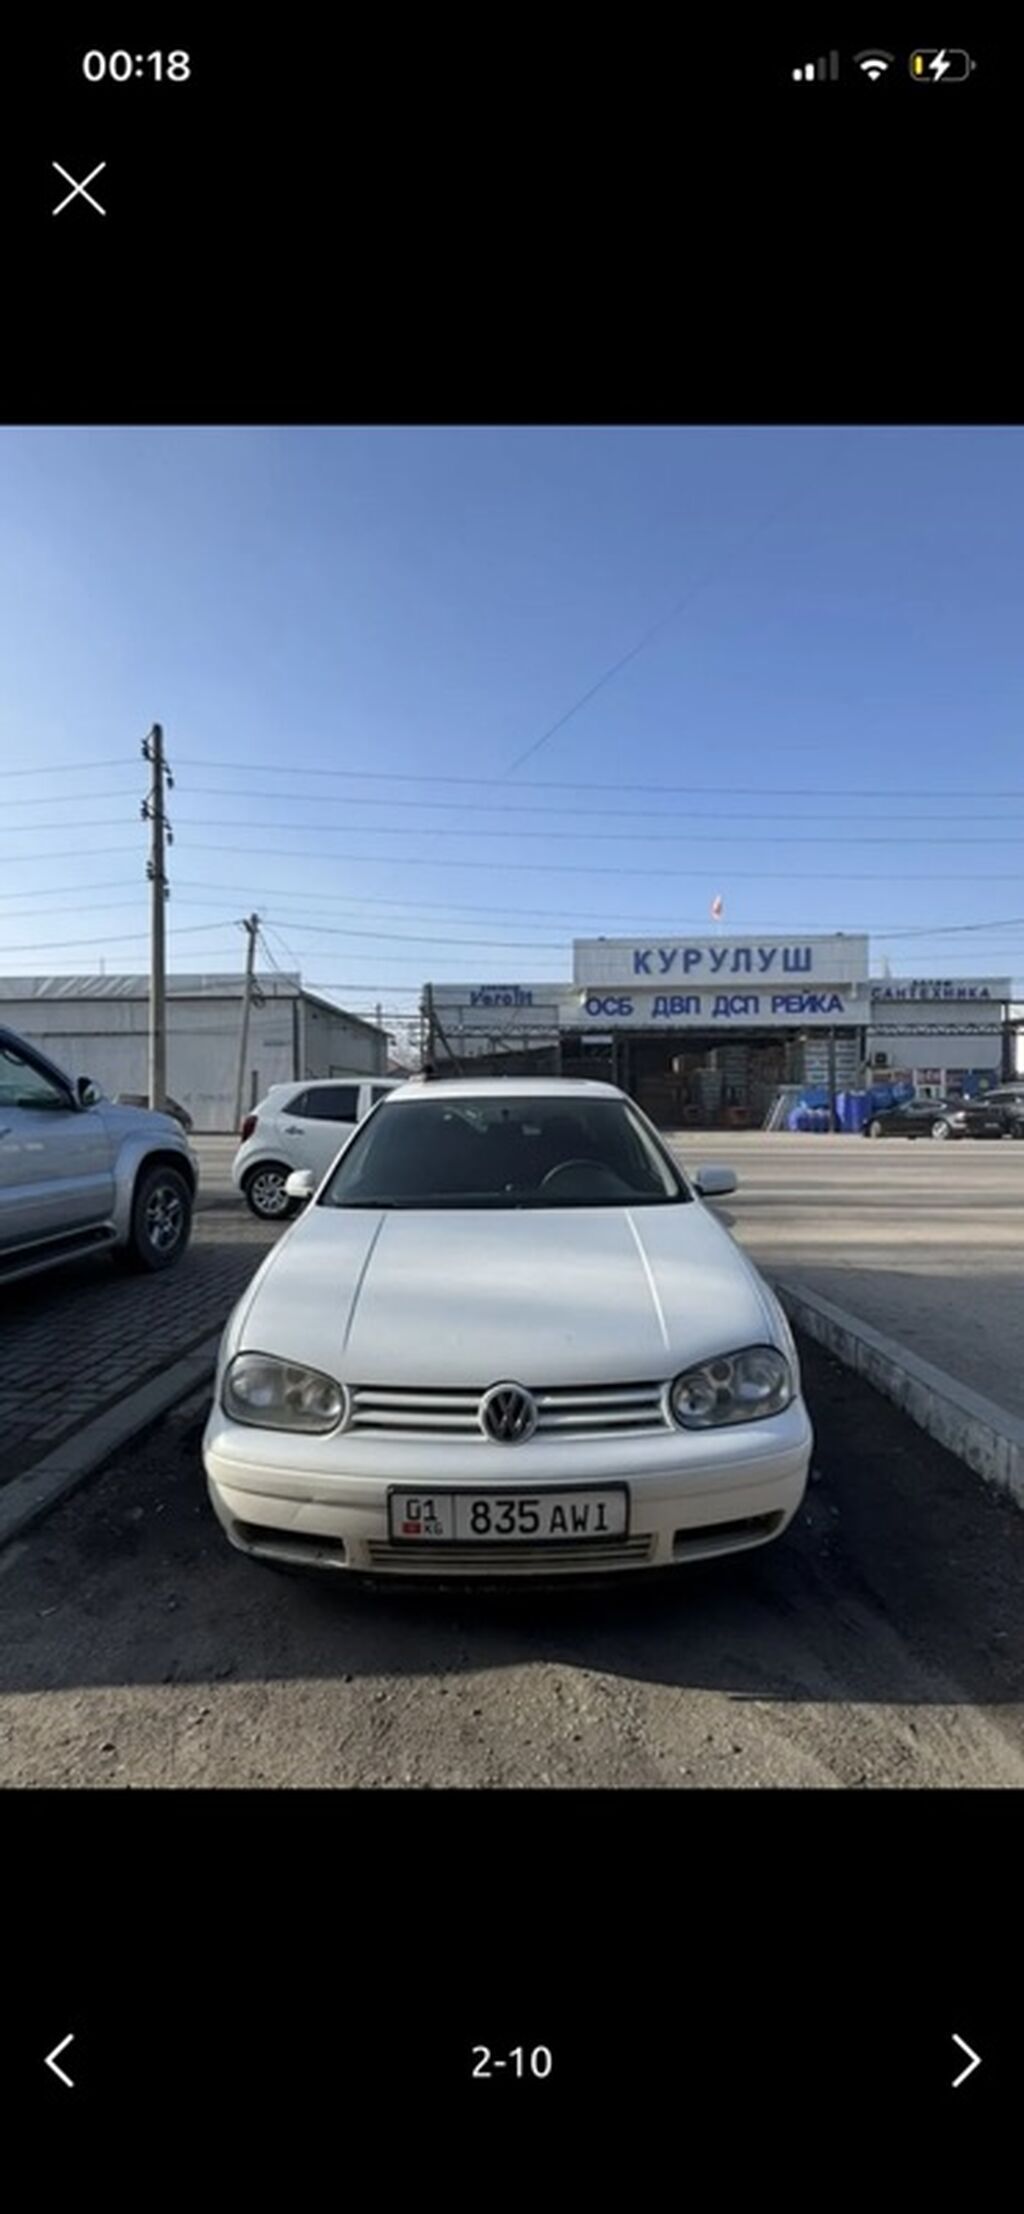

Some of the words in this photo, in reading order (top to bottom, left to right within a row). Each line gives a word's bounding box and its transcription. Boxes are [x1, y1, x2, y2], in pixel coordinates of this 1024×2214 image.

[632, 947, 813, 976] КУРУЛУШ
[584, 996, 634, 1017] ОСБ
[651, 995, 700, 1018] ДВП
[711, 994, 760, 1018] ДСП
[771, 990, 844, 1014] РЕЙКА
[871, 986, 991, 1001] САНТЕХНИКА
[406, 1498, 438, 1522] 01
[470, 1499, 541, 1536] 835
[549, 1502, 609, 1534] AWI
[423, 1522, 444, 1535] KG
